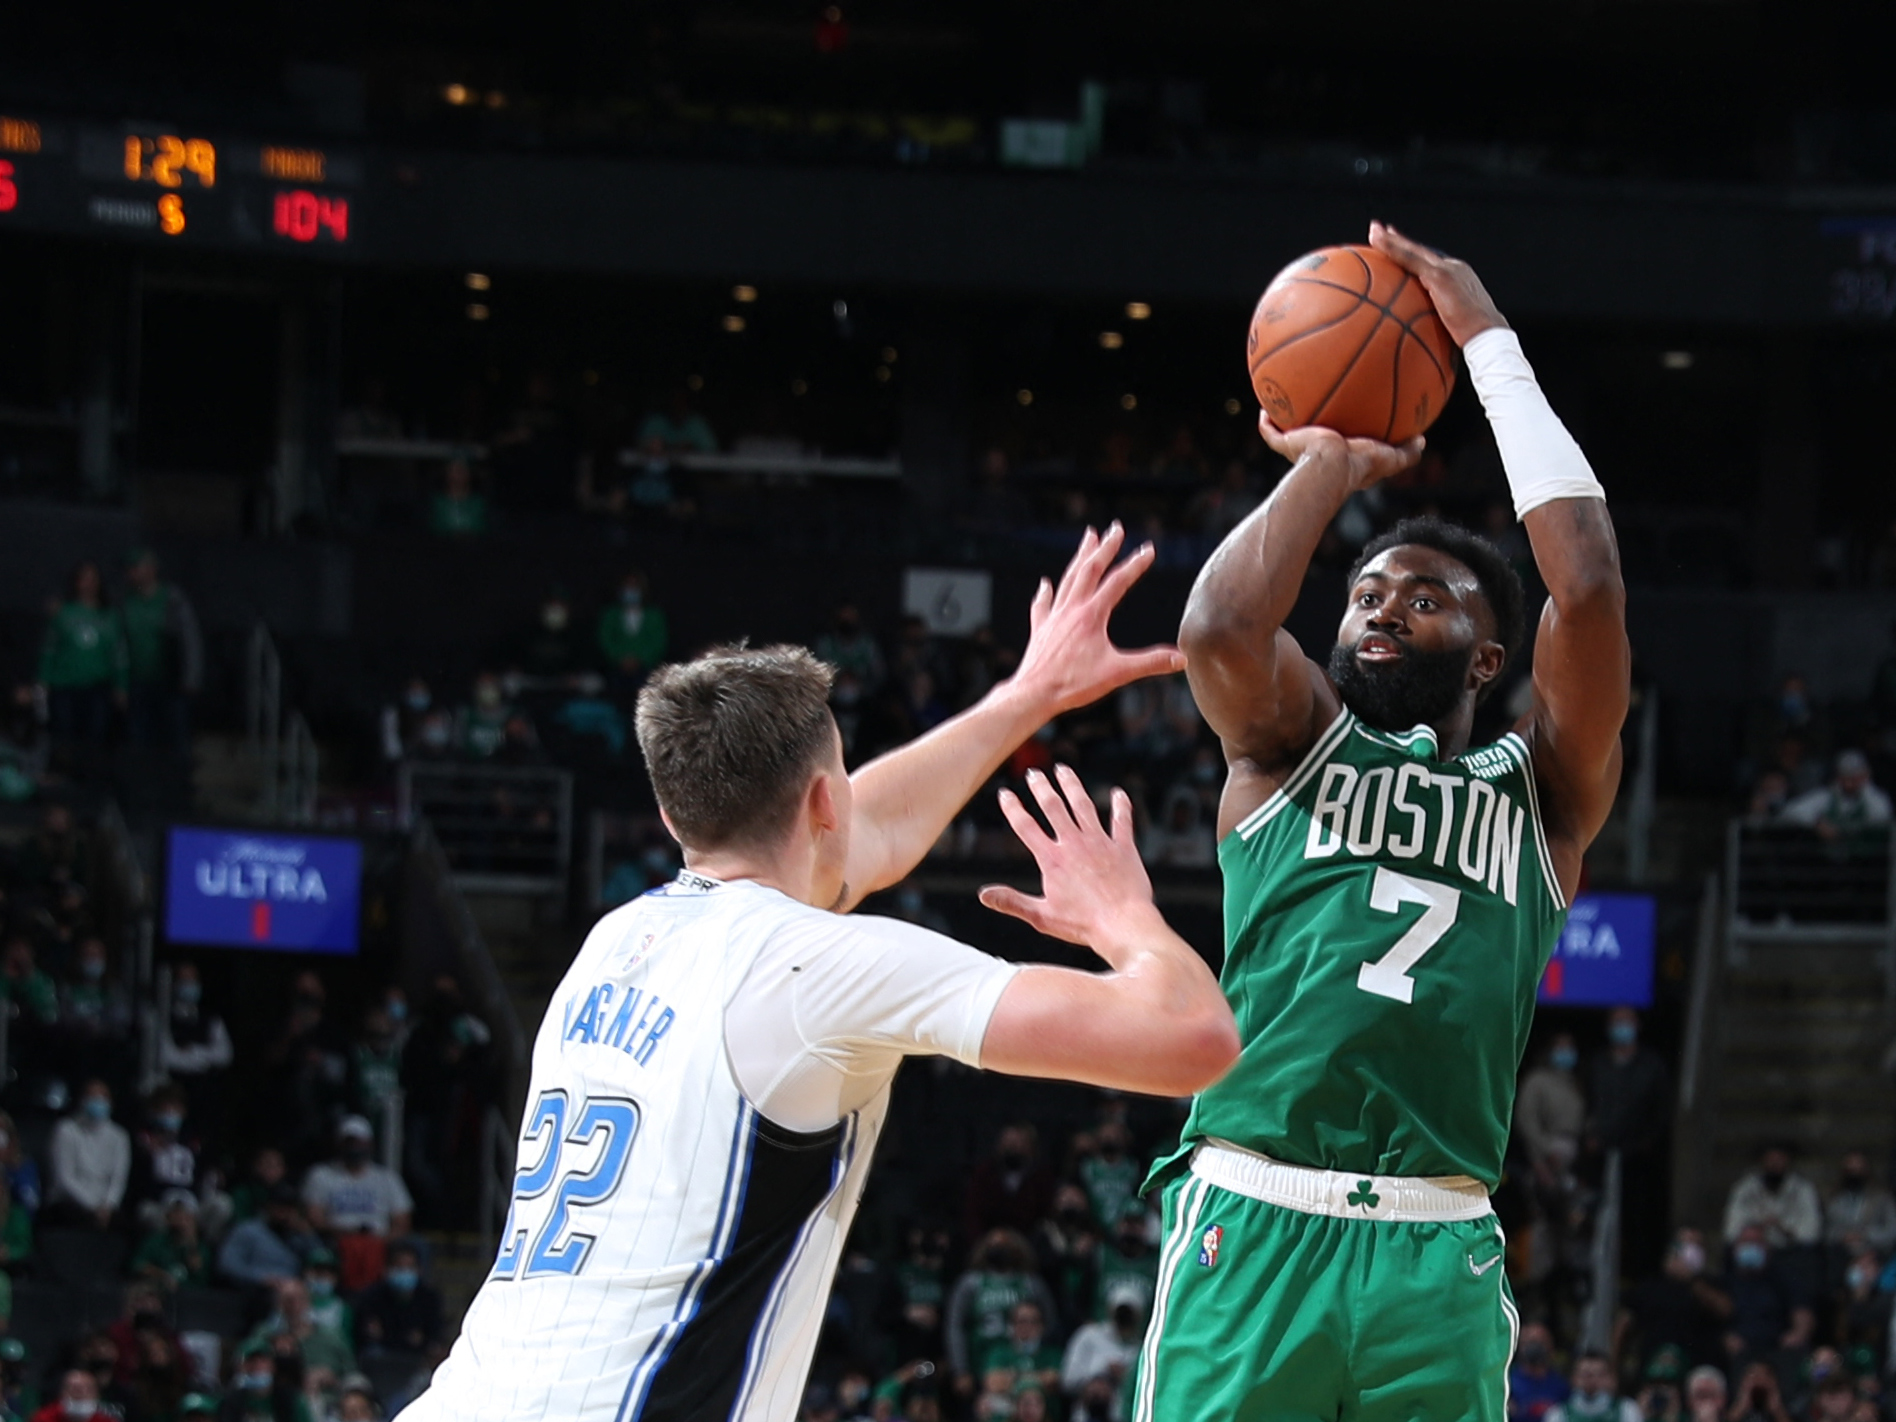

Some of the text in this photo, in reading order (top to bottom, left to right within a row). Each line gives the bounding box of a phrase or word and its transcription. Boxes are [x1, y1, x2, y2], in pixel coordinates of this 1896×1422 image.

[124, 134, 216, 188] 1:29
[273, 189, 349, 242] 104
[1459, 746, 1512, 771] VISTA
[1304, 762, 1525, 907] BOSTON
[195, 859, 328, 904] ULTRA
[1357, 866, 1462, 1004] 7
[488, 1088, 642, 1282] 22
